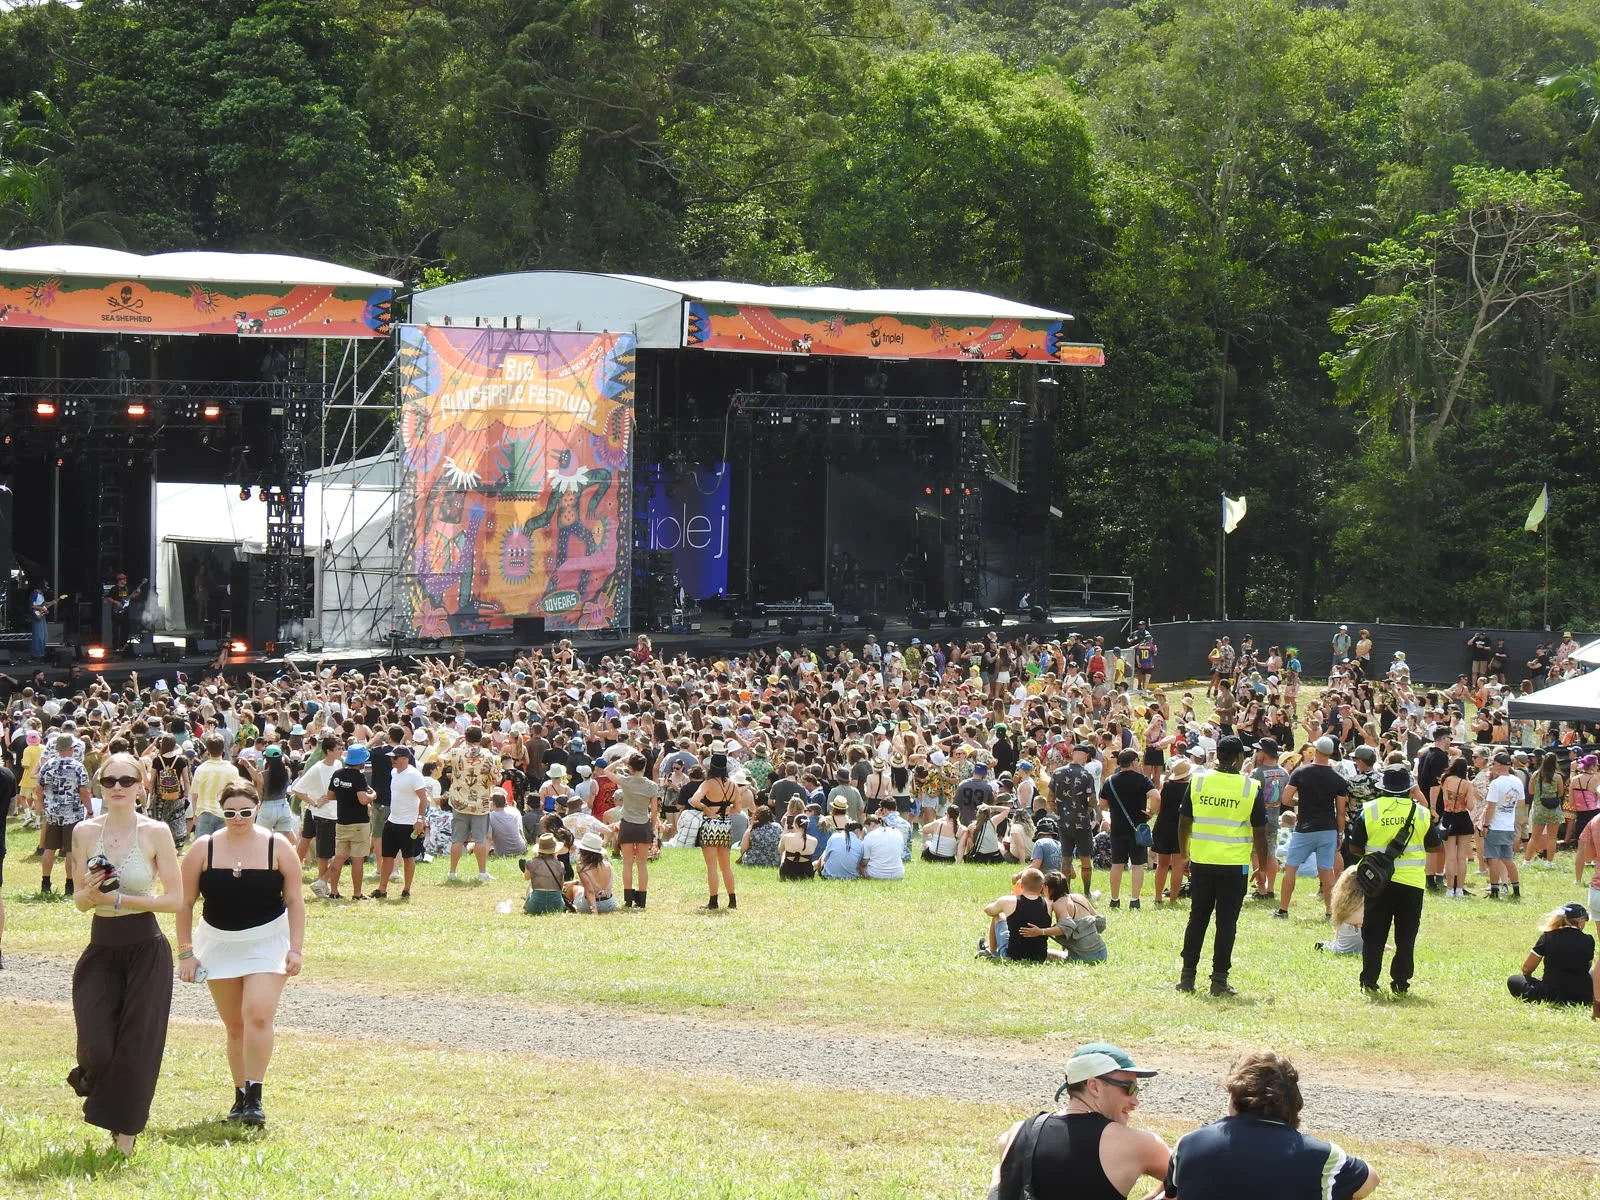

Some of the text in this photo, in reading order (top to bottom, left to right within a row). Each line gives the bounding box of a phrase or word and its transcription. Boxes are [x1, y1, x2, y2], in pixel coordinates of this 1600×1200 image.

[101, 314, 153, 323] SEA SHEPHERD
[505, 357, 534, 381] BIG
[440, 384, 598, 426] PINEAPPLE FESTIVAL
[1141, 649, 1149, 660] 10
[1199, 795, 1240, 809] SECURITY
